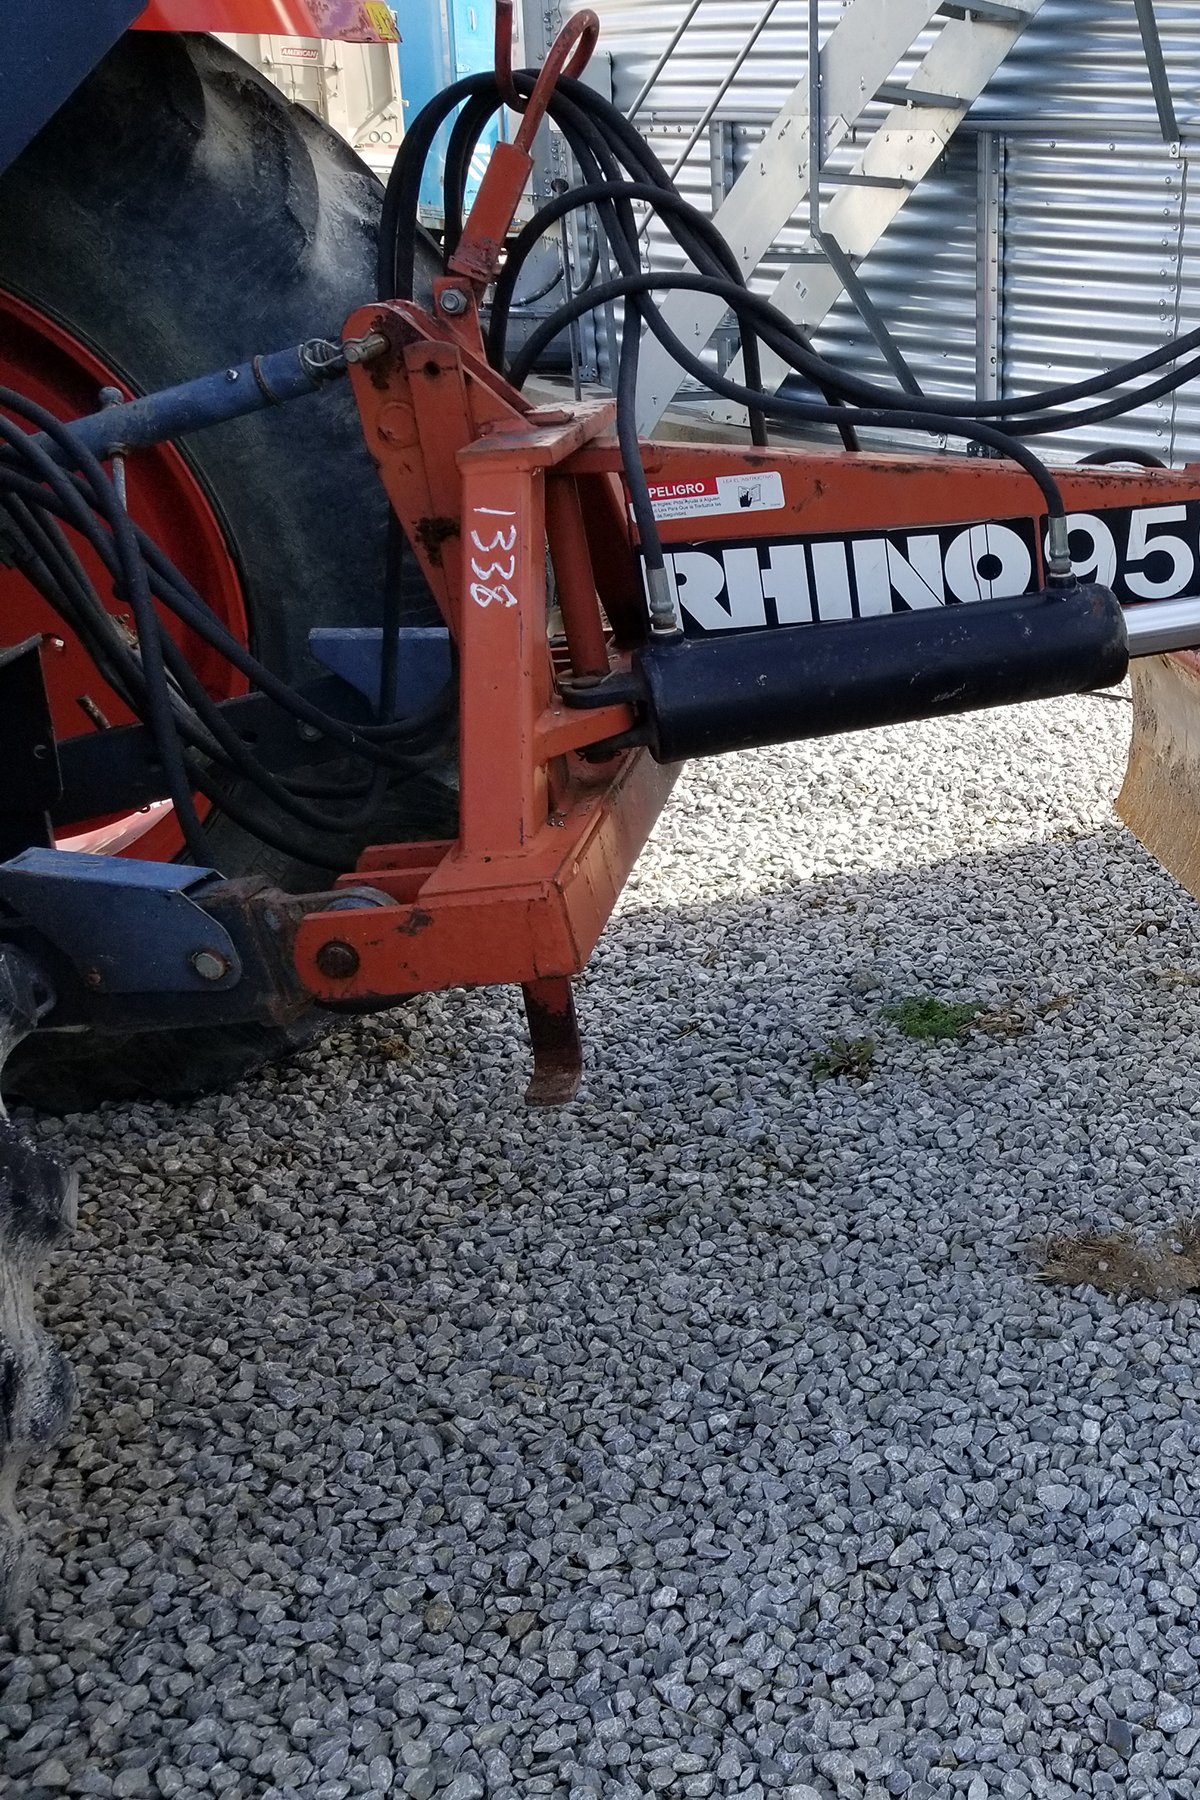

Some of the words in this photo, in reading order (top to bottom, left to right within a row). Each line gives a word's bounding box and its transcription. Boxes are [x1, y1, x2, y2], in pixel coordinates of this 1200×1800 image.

[282, 48, 317, 58] AMERICAN
[648, 482, 705, 498] PELIGRO
[469, 507, 518, 608] 1338
[641, 524, 1032, 633] RHINO
